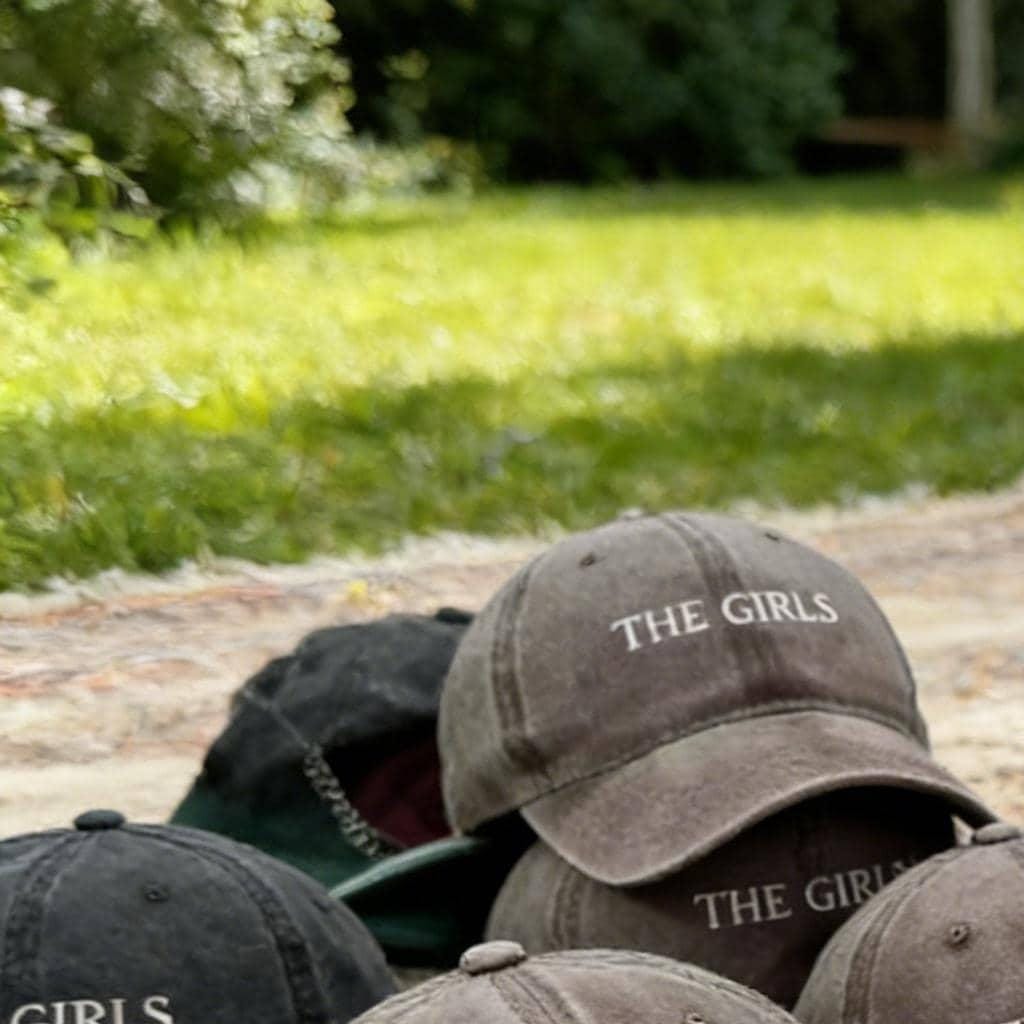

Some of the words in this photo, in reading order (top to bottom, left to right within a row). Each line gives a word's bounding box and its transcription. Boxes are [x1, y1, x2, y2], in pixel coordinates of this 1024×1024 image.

[609, 599, 710, 652] THE
[721, 590, 839, 626] GIRLS
[693, 883, 792, 930] THE
